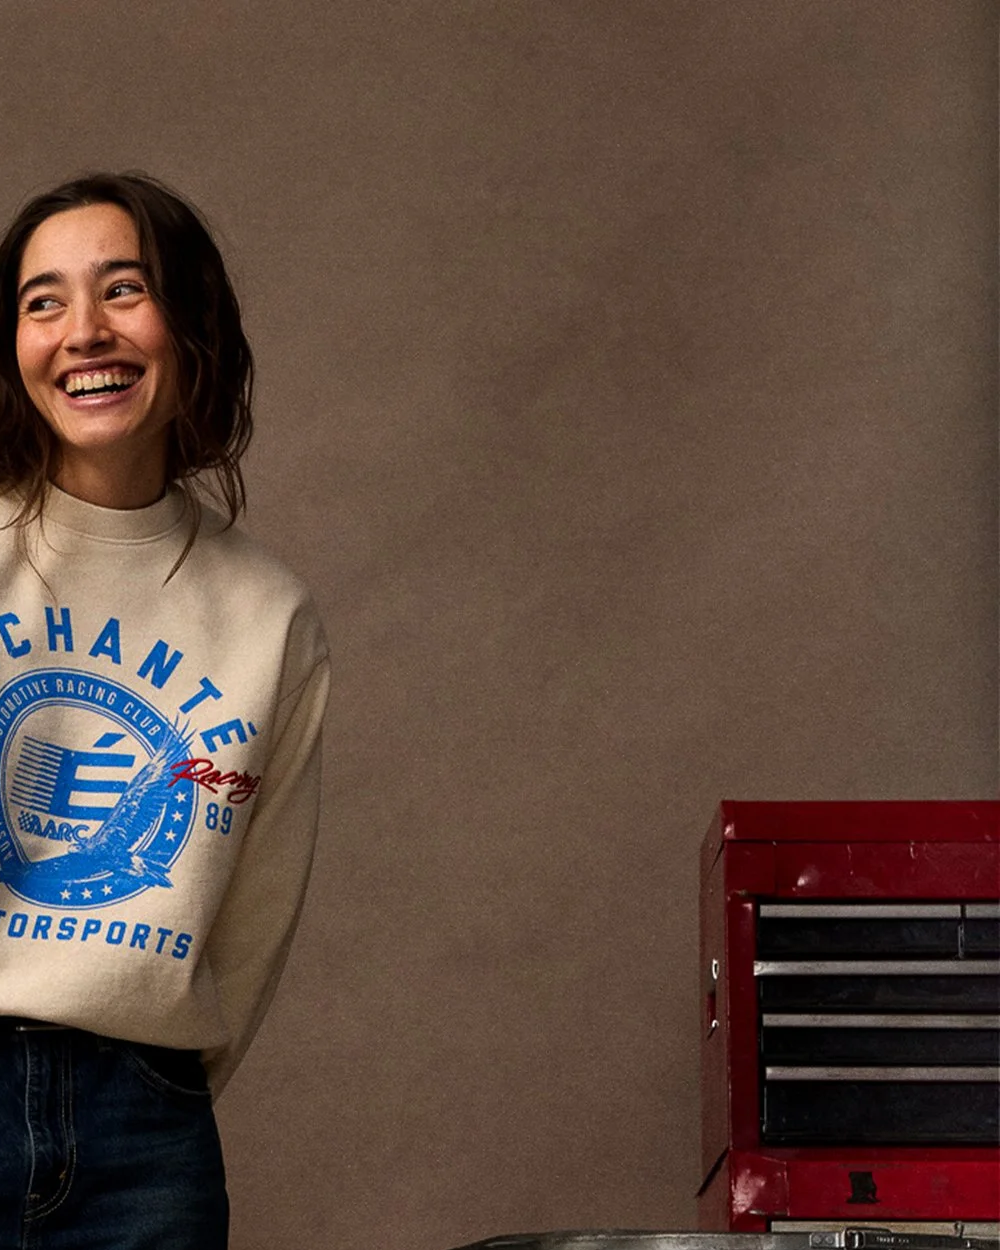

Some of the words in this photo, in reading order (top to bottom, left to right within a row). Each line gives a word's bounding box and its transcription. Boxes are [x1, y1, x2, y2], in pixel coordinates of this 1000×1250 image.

[55, 677, 117, 706] RACING
[122, 701, 162, 737] CLUB
[167, 757, 261, 804] Racing
[205, 802, 232, 835] 89
